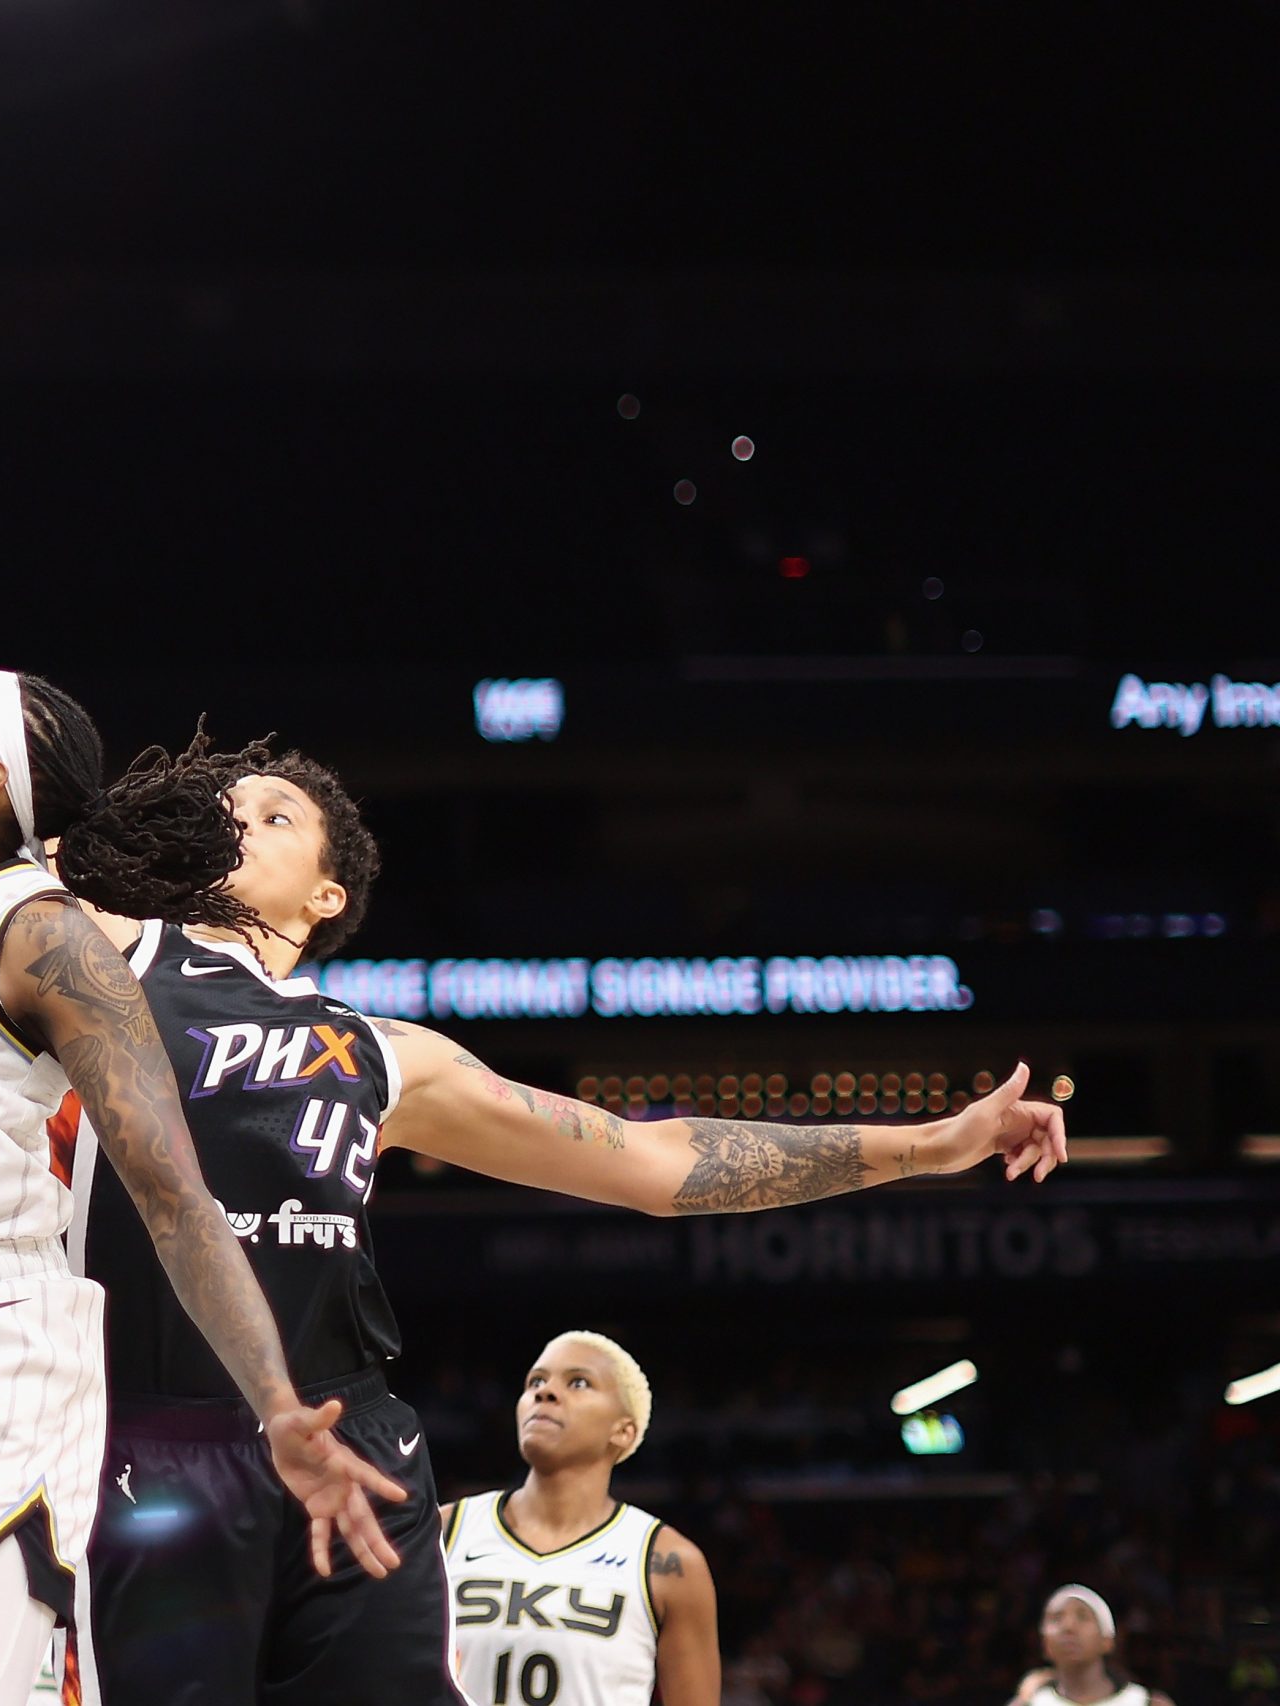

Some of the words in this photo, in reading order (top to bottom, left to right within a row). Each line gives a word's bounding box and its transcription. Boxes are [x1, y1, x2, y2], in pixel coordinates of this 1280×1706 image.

[1109, 673, 1209, 738] Any
[186, 1022, 361, 1098] PHX
[289, 1096, 378, 1195] 42
[267, 1198, 357, 1249] fry's
[689, 1207, 1102, 1284] HORNITOS
[456, 1580, 626, 1639] SKY
[494, 1648, 559, 1706] 10
